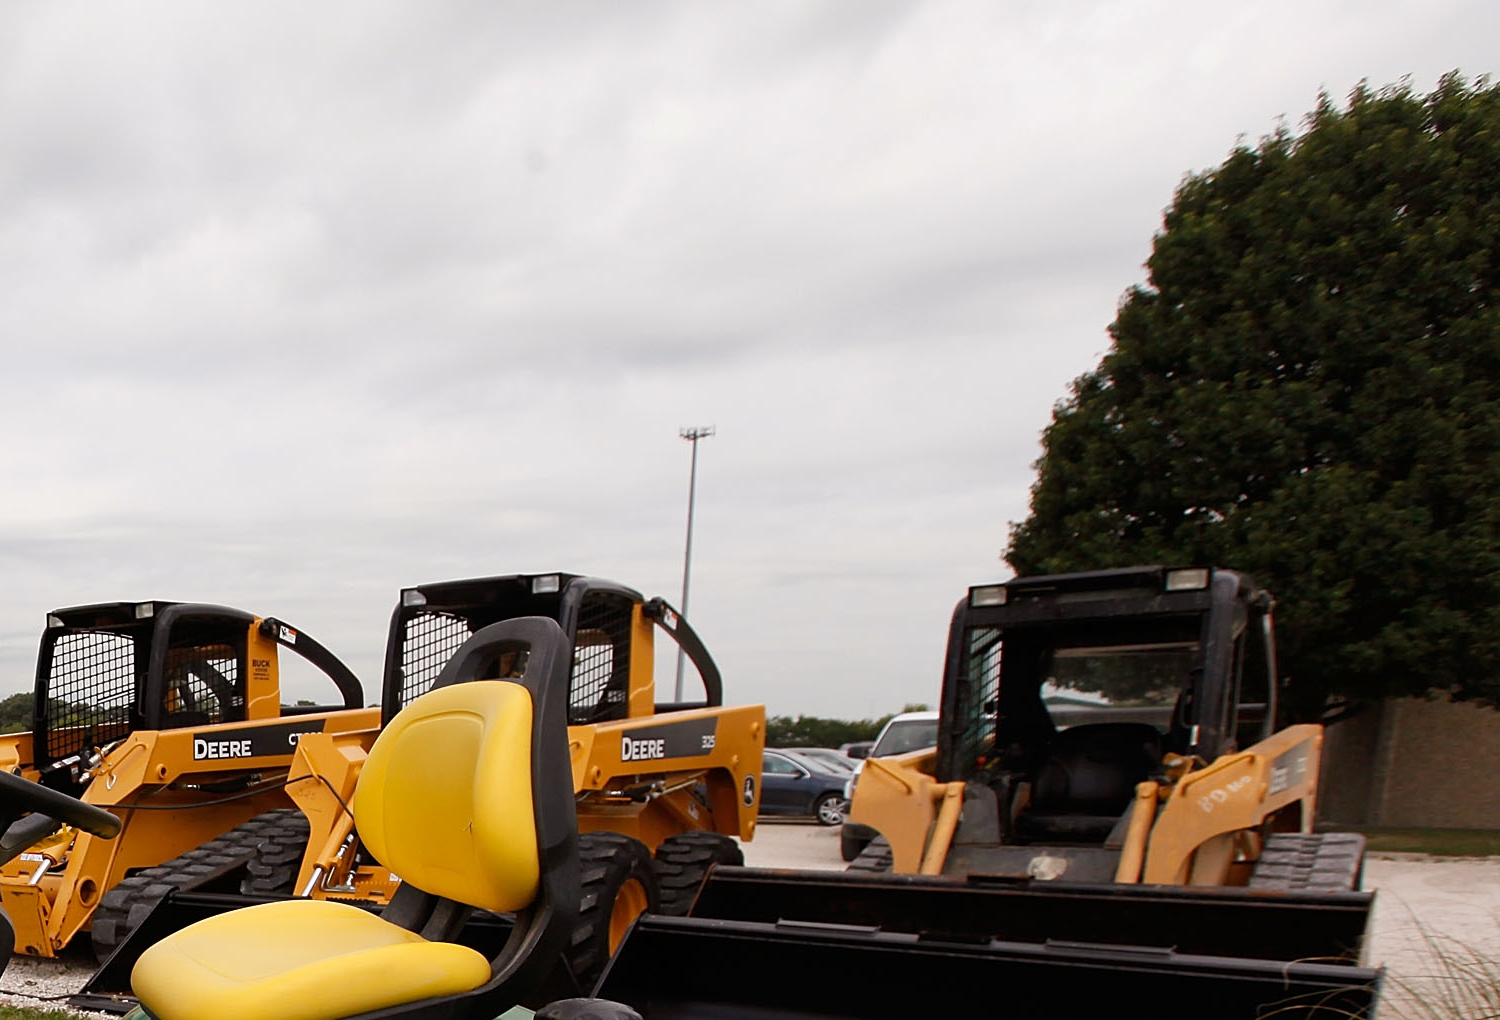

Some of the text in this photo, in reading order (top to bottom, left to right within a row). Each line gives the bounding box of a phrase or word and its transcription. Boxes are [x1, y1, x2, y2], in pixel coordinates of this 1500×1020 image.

[252, 659, 270, 667] BUCK
[194, 739, 252, 760] DEERE
[622, 737, 665, 761] DEERE
